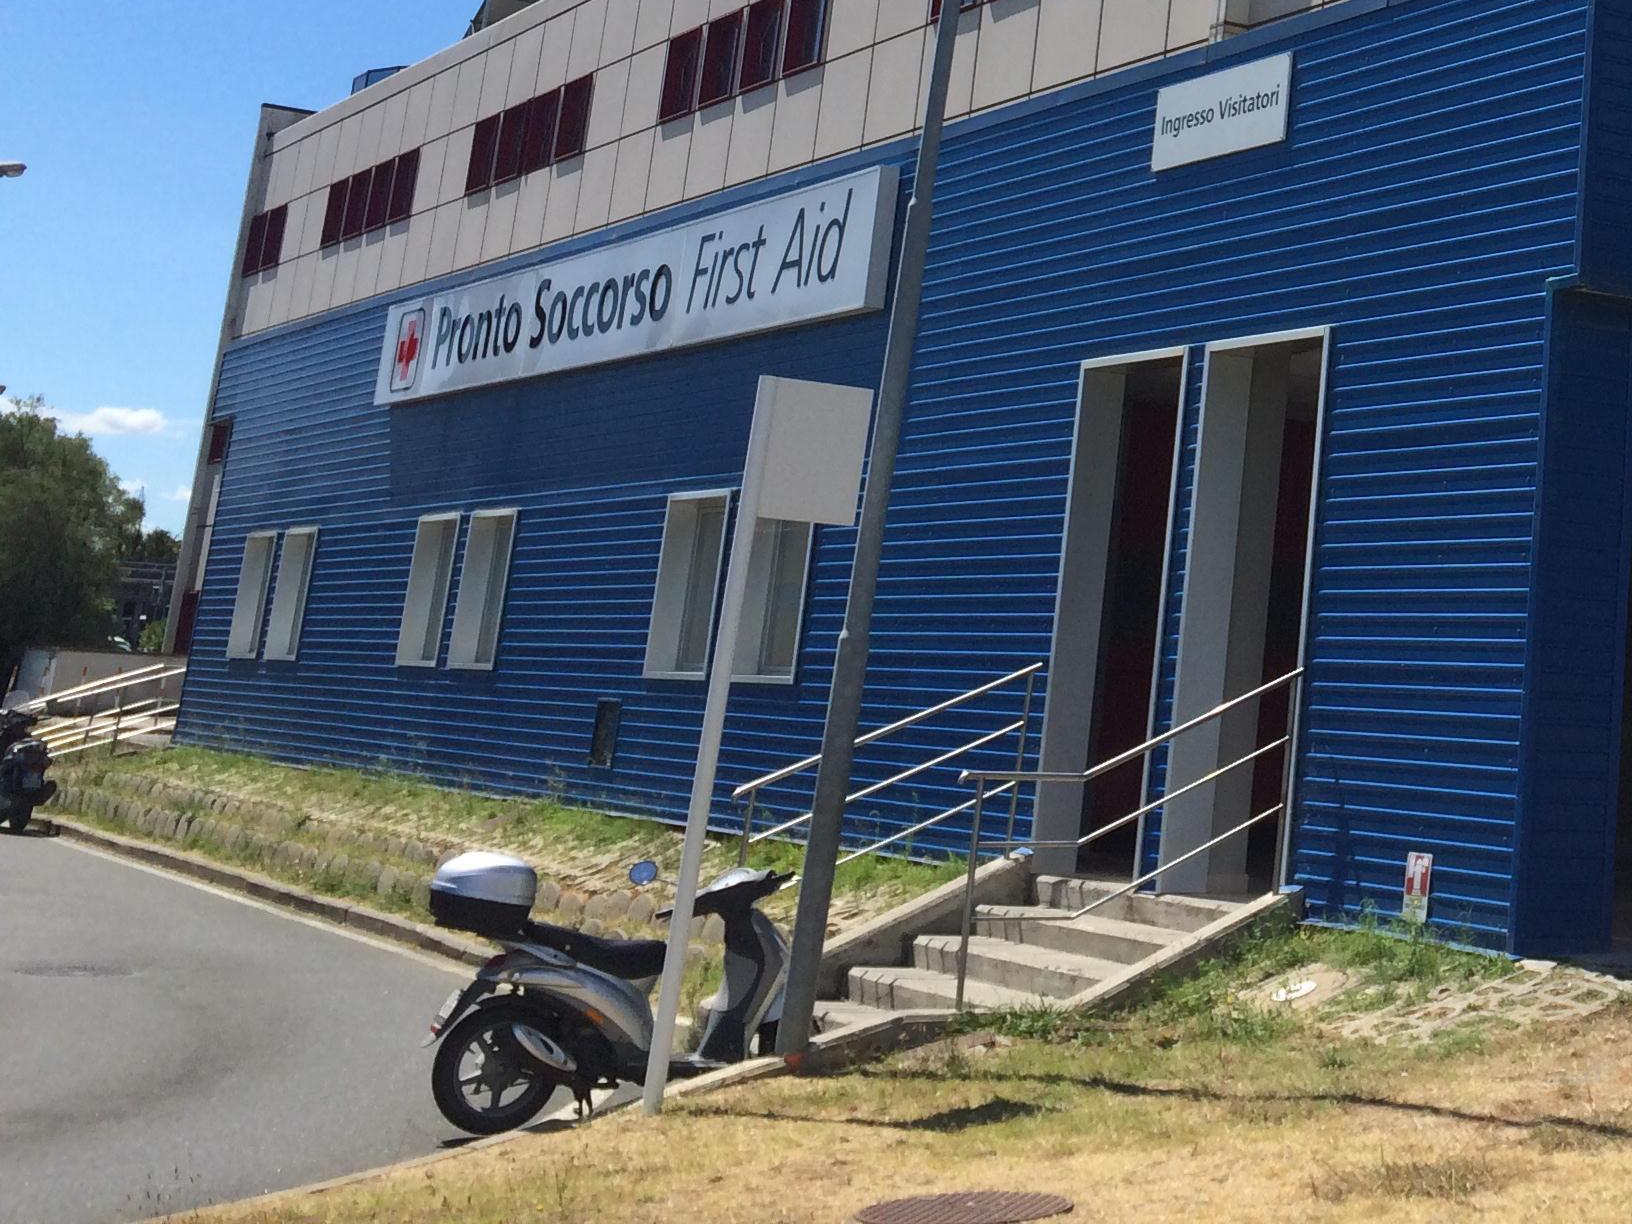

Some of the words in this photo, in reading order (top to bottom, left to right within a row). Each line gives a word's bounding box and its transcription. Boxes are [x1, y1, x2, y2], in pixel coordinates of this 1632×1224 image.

[1160, 107, 1215, 138] Ingresso
[1218, 83, 1281, 120] Visitatori
[431, 295, 522, 370] Pronto
[528, 263, 673, 349] Soccorso
[686, 223, 768, 314] First
[772, 187, 854, 295] Aid
